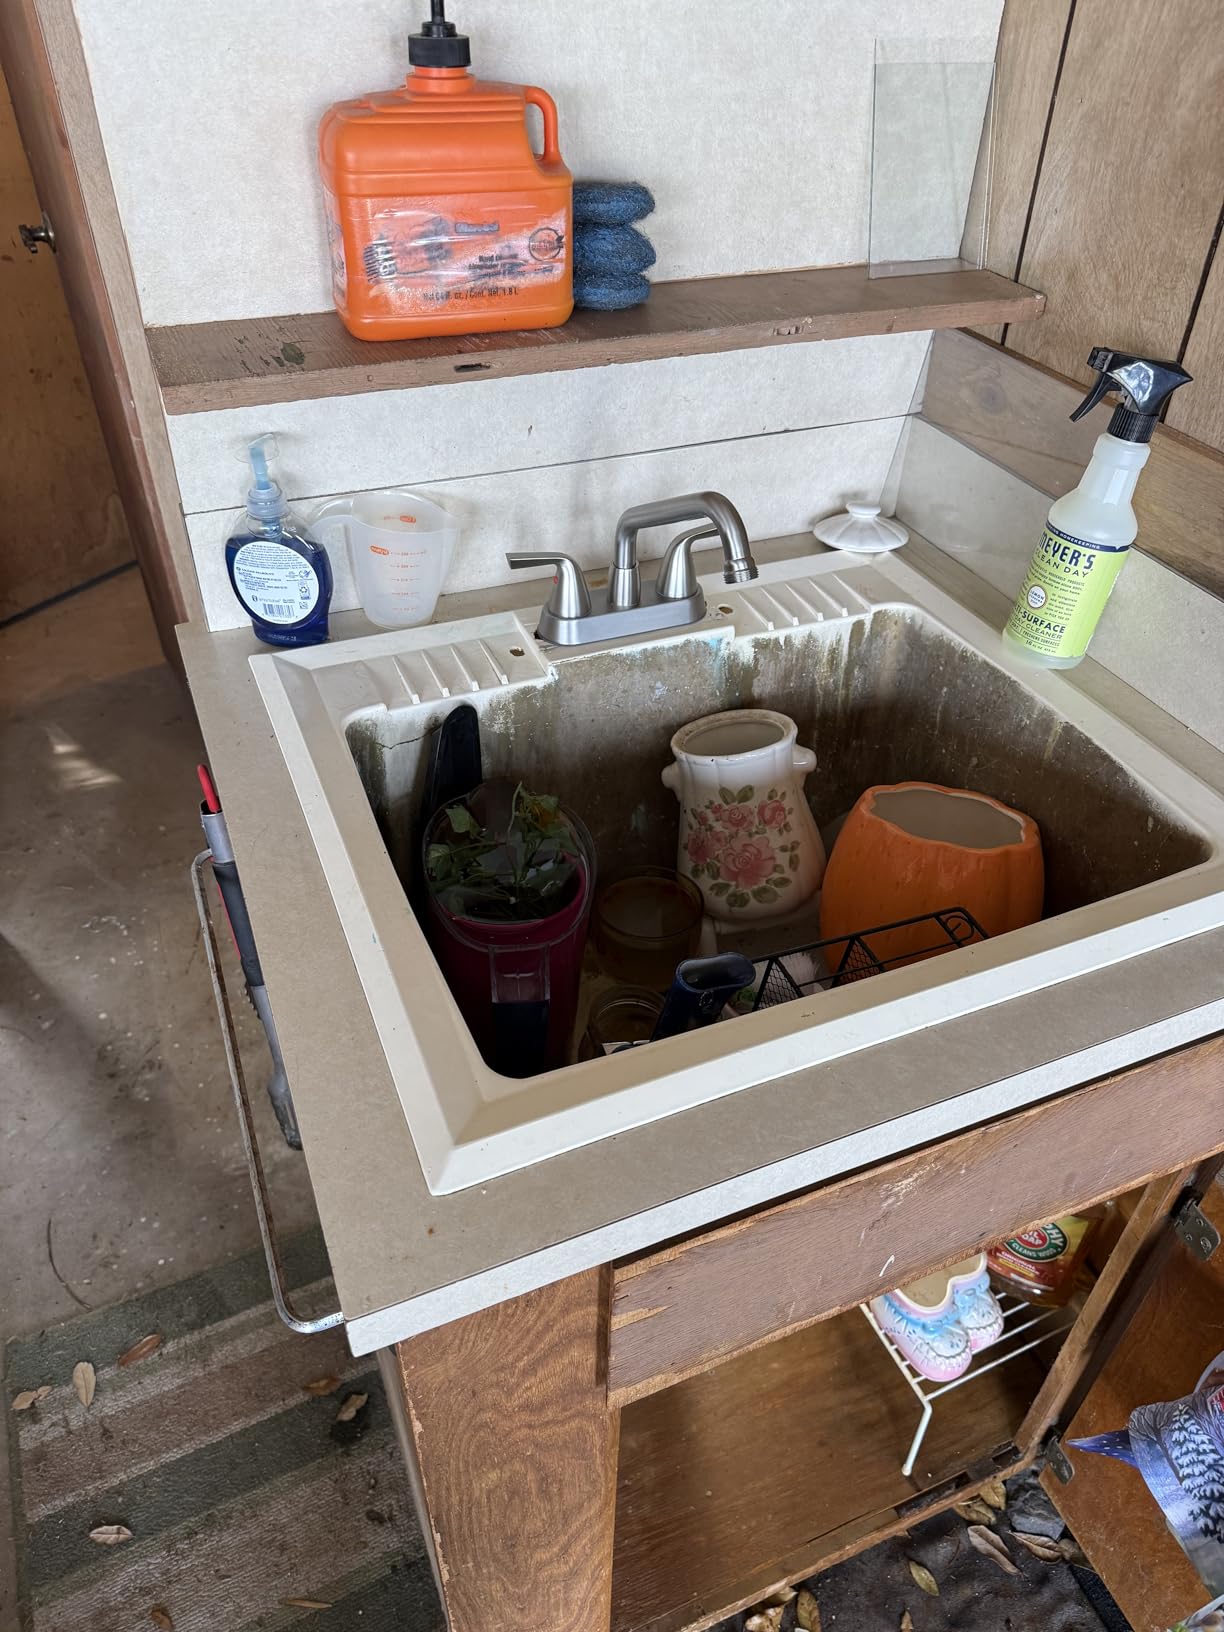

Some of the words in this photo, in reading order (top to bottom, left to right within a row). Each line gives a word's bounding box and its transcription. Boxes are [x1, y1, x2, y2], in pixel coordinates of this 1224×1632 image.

[1039, 531, 1096, 570] MEYER'S
[1063, 566, 1089, 578] DAY
[1025, 623, 1063, 640] CLEANER
[1012, 1242, 1037, 1258] CLEANS
